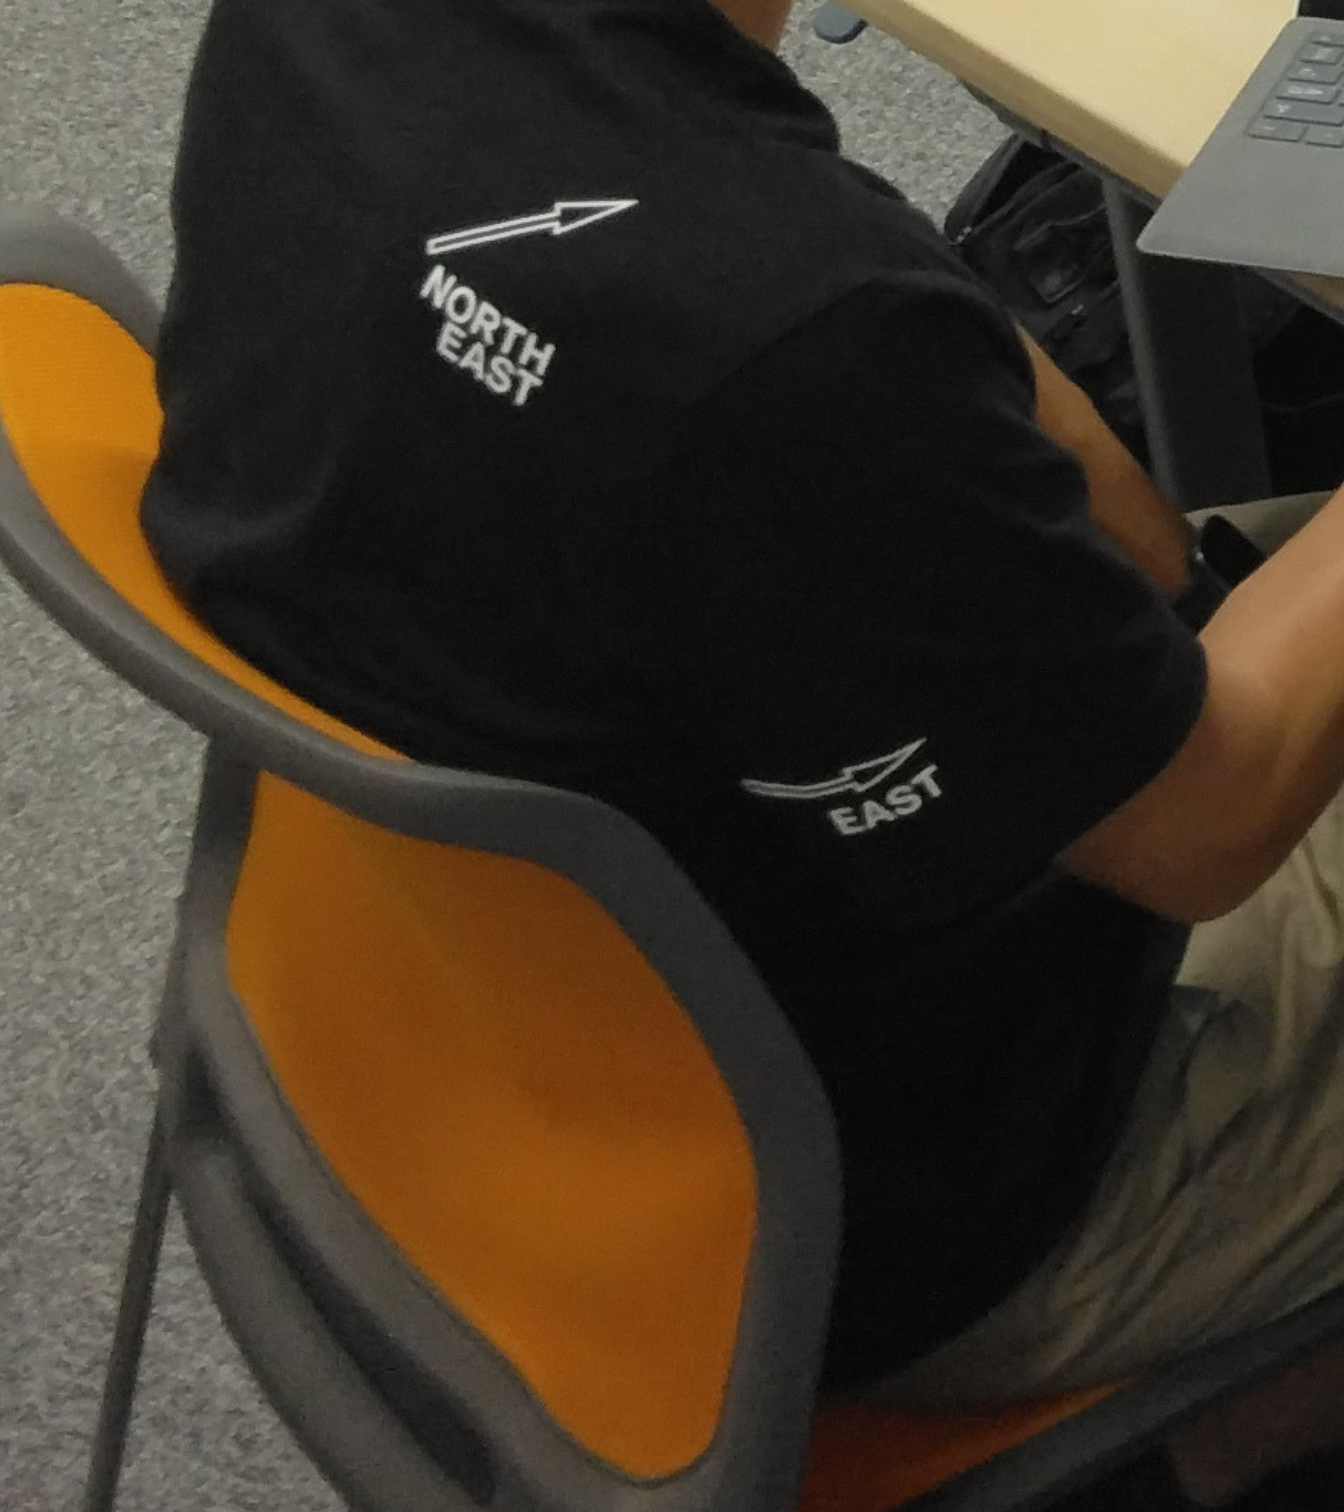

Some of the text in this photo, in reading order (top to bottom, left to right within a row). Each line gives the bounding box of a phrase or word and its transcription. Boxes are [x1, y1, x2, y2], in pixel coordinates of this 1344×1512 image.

[419, 264, 556, 376] NORTH
[436, 321, 544, 407] EAST
[828, 763, 943, 836] EAST
